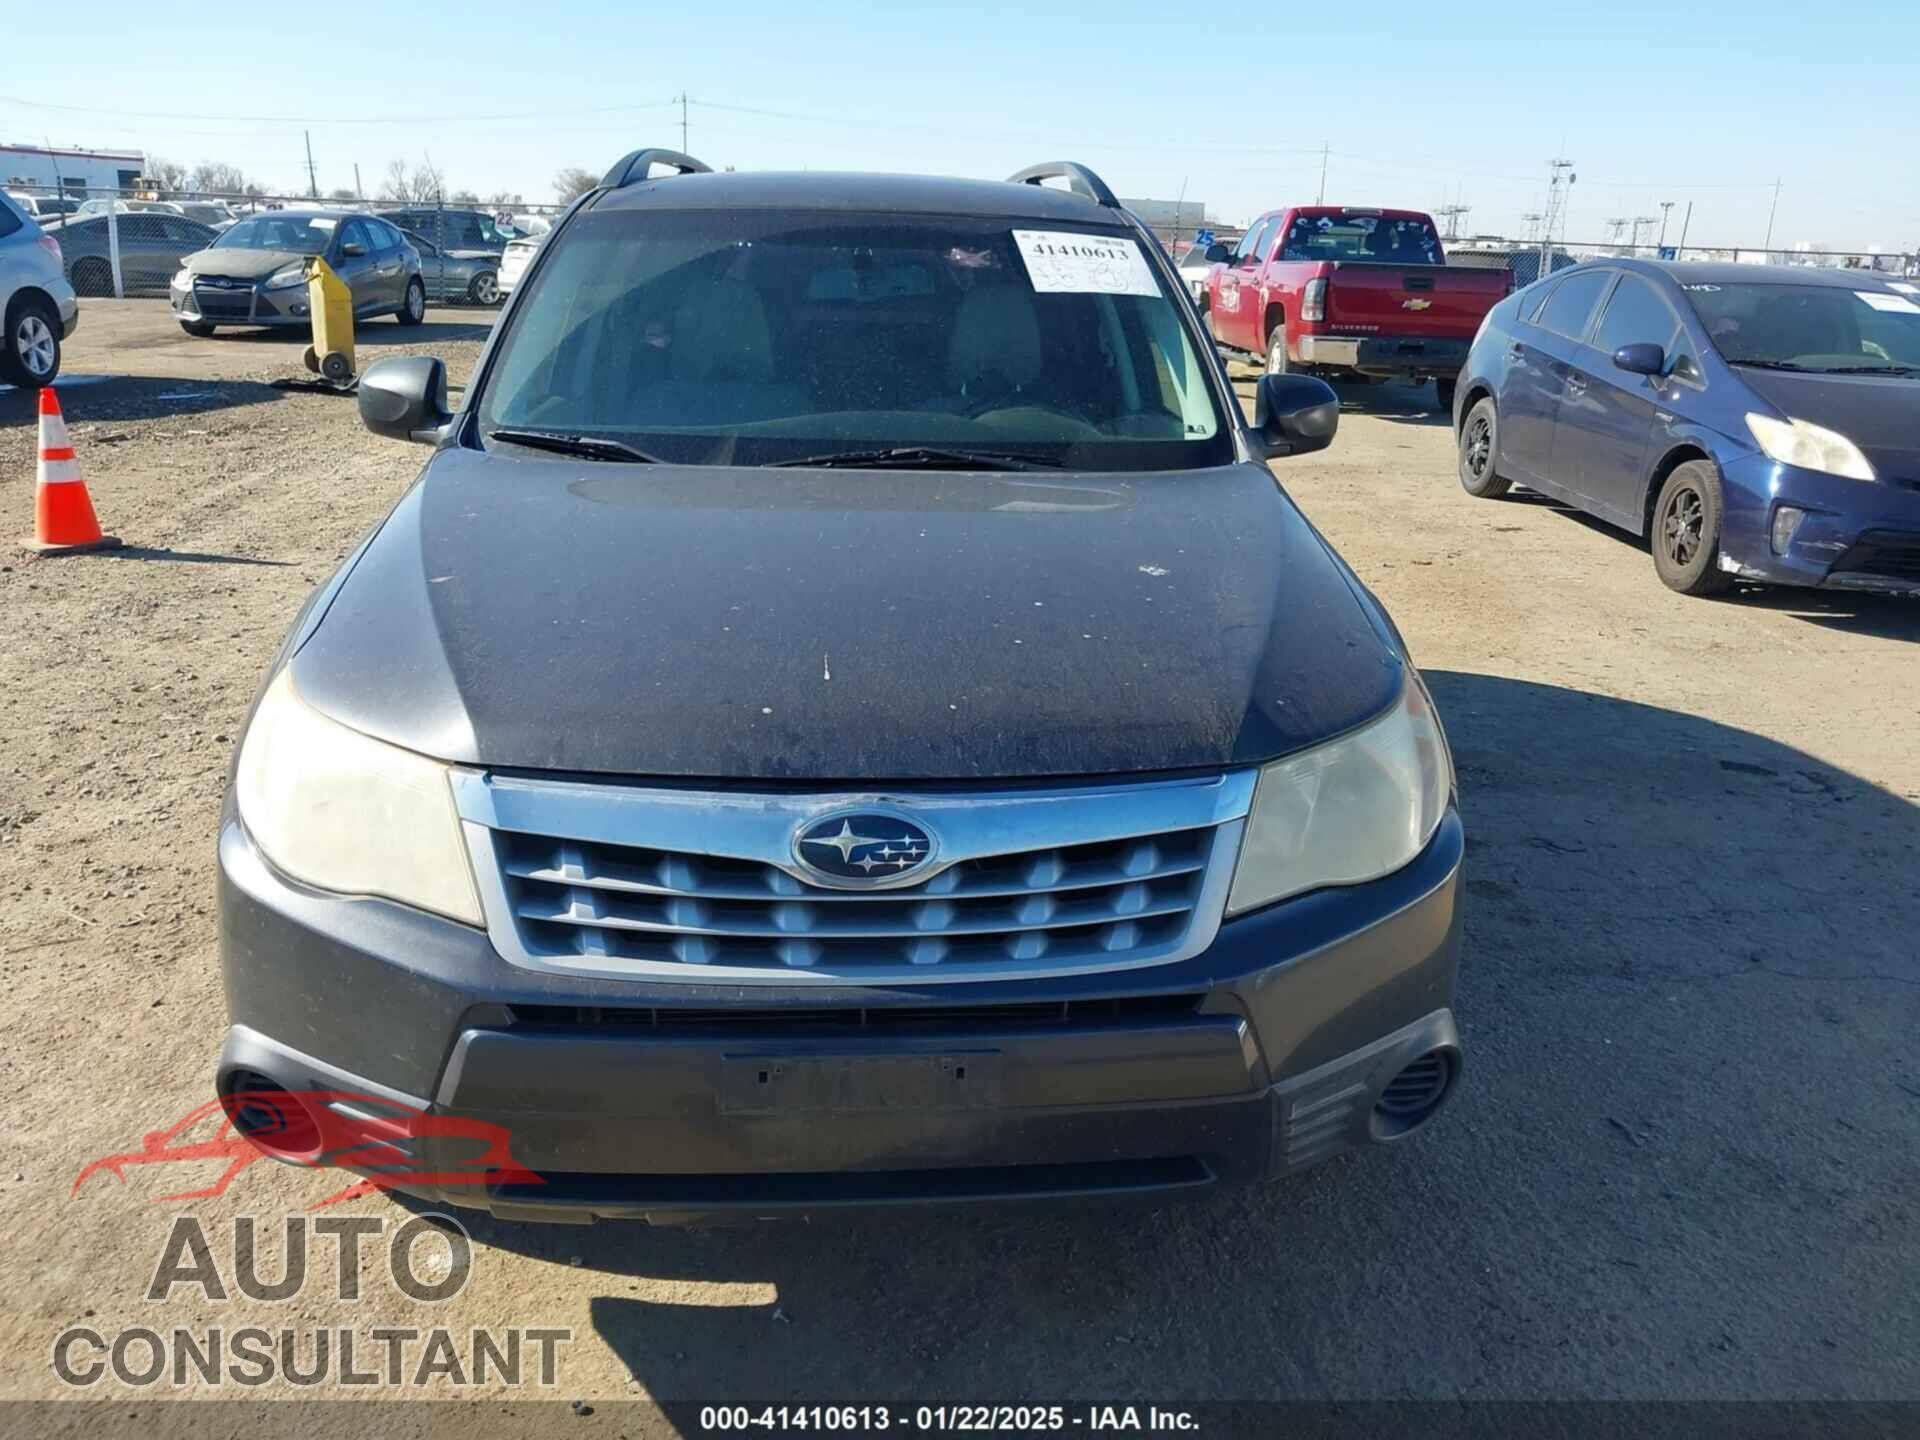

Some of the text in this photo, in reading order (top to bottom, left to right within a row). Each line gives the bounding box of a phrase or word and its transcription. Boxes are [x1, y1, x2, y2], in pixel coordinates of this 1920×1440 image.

[497, 211, 513, 226] 22
[1197, 228, 1214, 247] 25
[1033, 244, 1130, 261] 41410613
